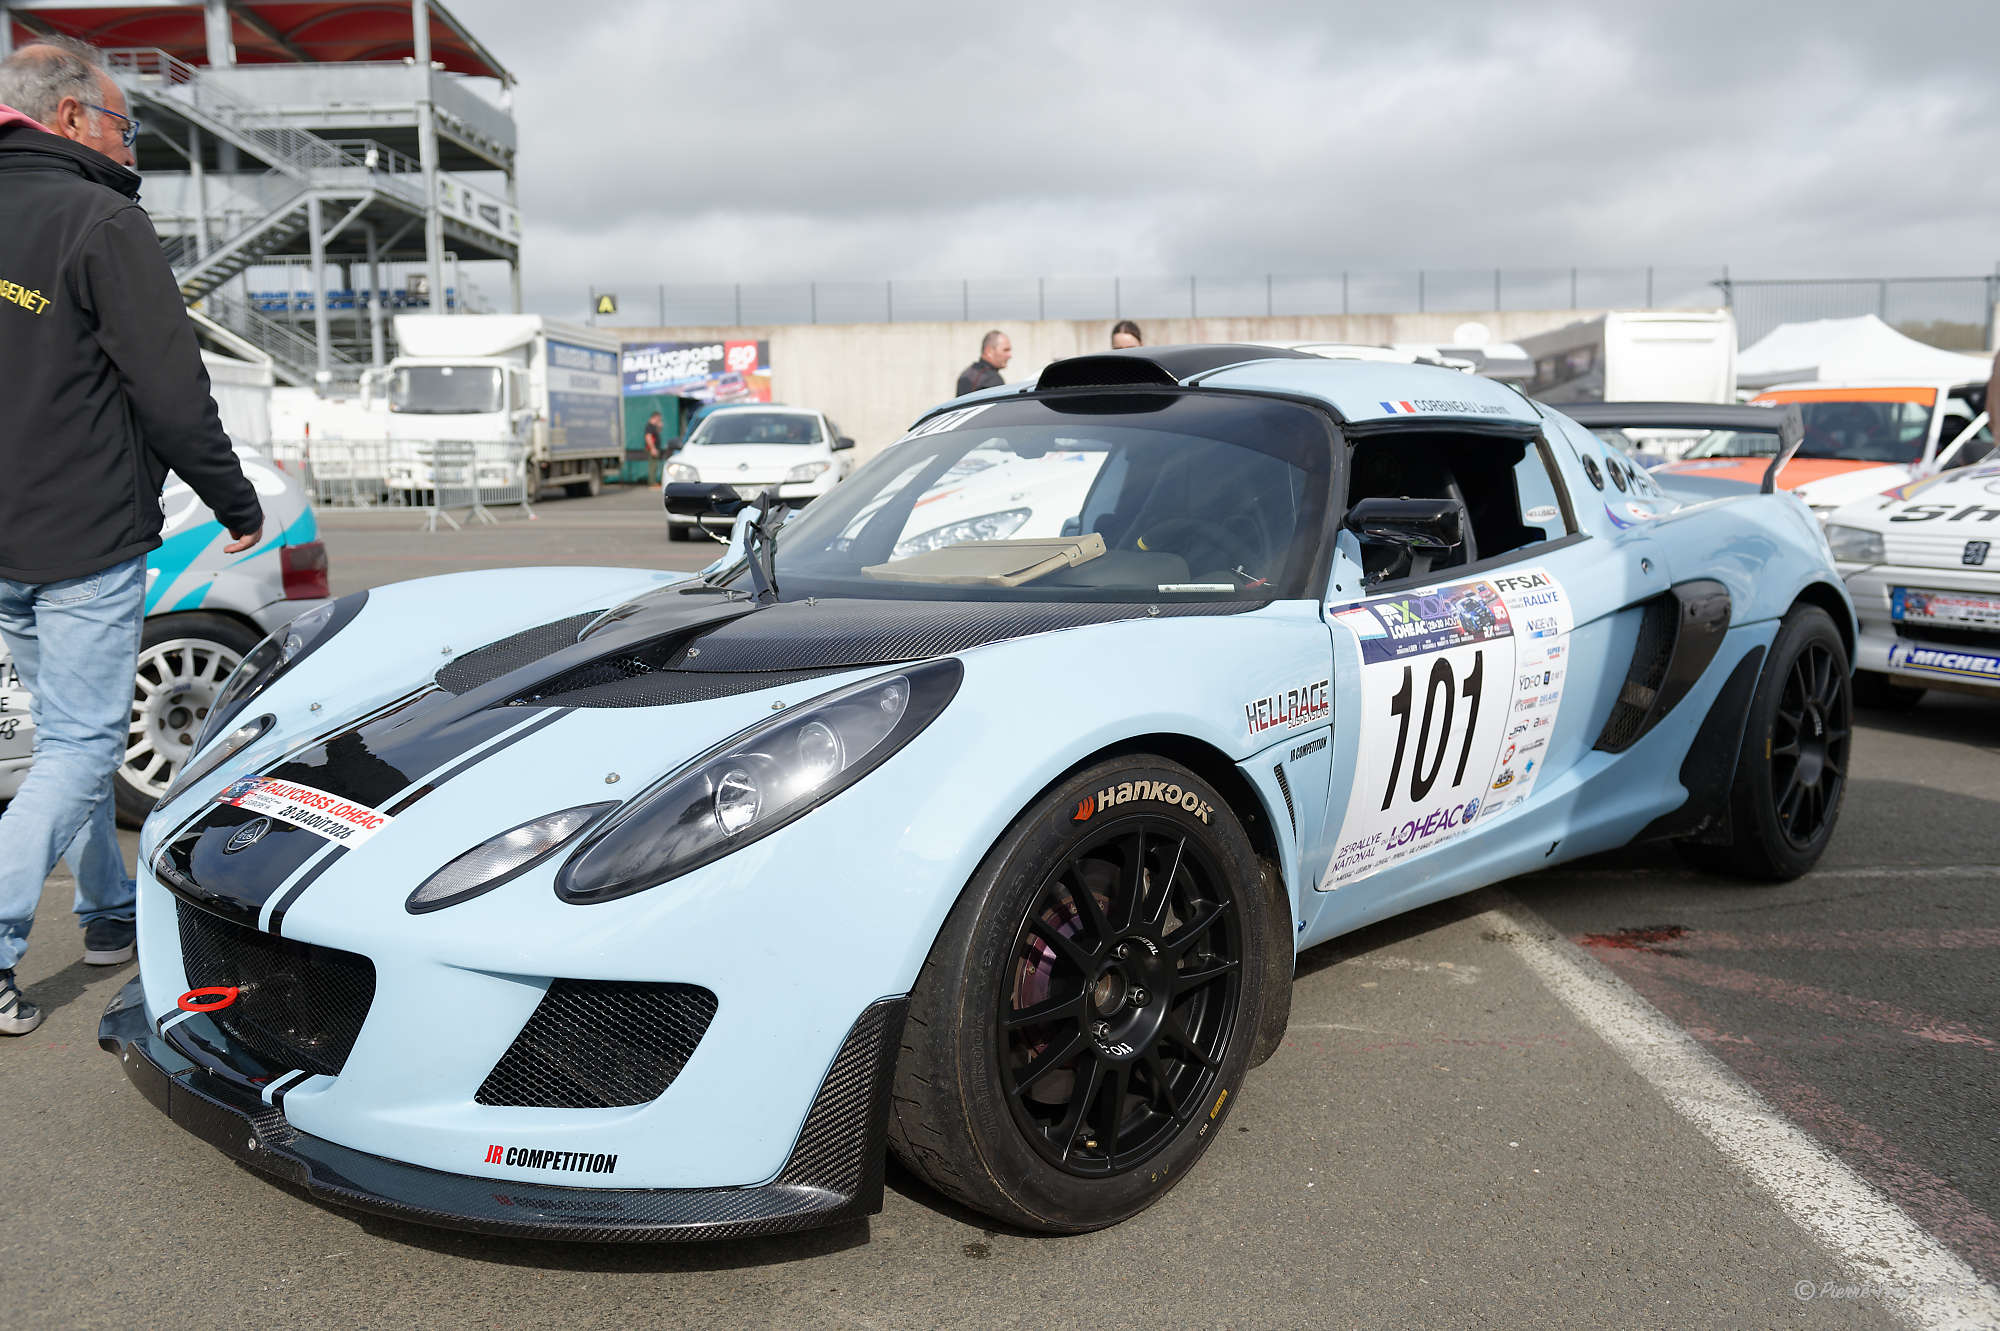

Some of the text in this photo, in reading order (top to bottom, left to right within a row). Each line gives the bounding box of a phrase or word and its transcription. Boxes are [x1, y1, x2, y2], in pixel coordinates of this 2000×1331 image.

[598, 295, 614, 313] A
[1494, 574, 1547, 592] FFSA
[1522, 591, 1559, 607] RALLYE
[1913, 649, 2000, 674] MICHEL
[1245, 680, 1329, 734] HELLRACE
[1381, 650, 1483, 812] 101
[261, 782, 384, 830] RALLYCROSS LOHÉAC
[300, 813, 332, 831] AOÛT
[323, 822, 355, 840] 2026
[1350, 832, 1383, 854] RALLYE
[1385, 804, 1464, 850] LOHÉAC
[1331, 846, 1376, 872] NATIONAL
[484, 1144, 618, 1174] JR COMPETITION
